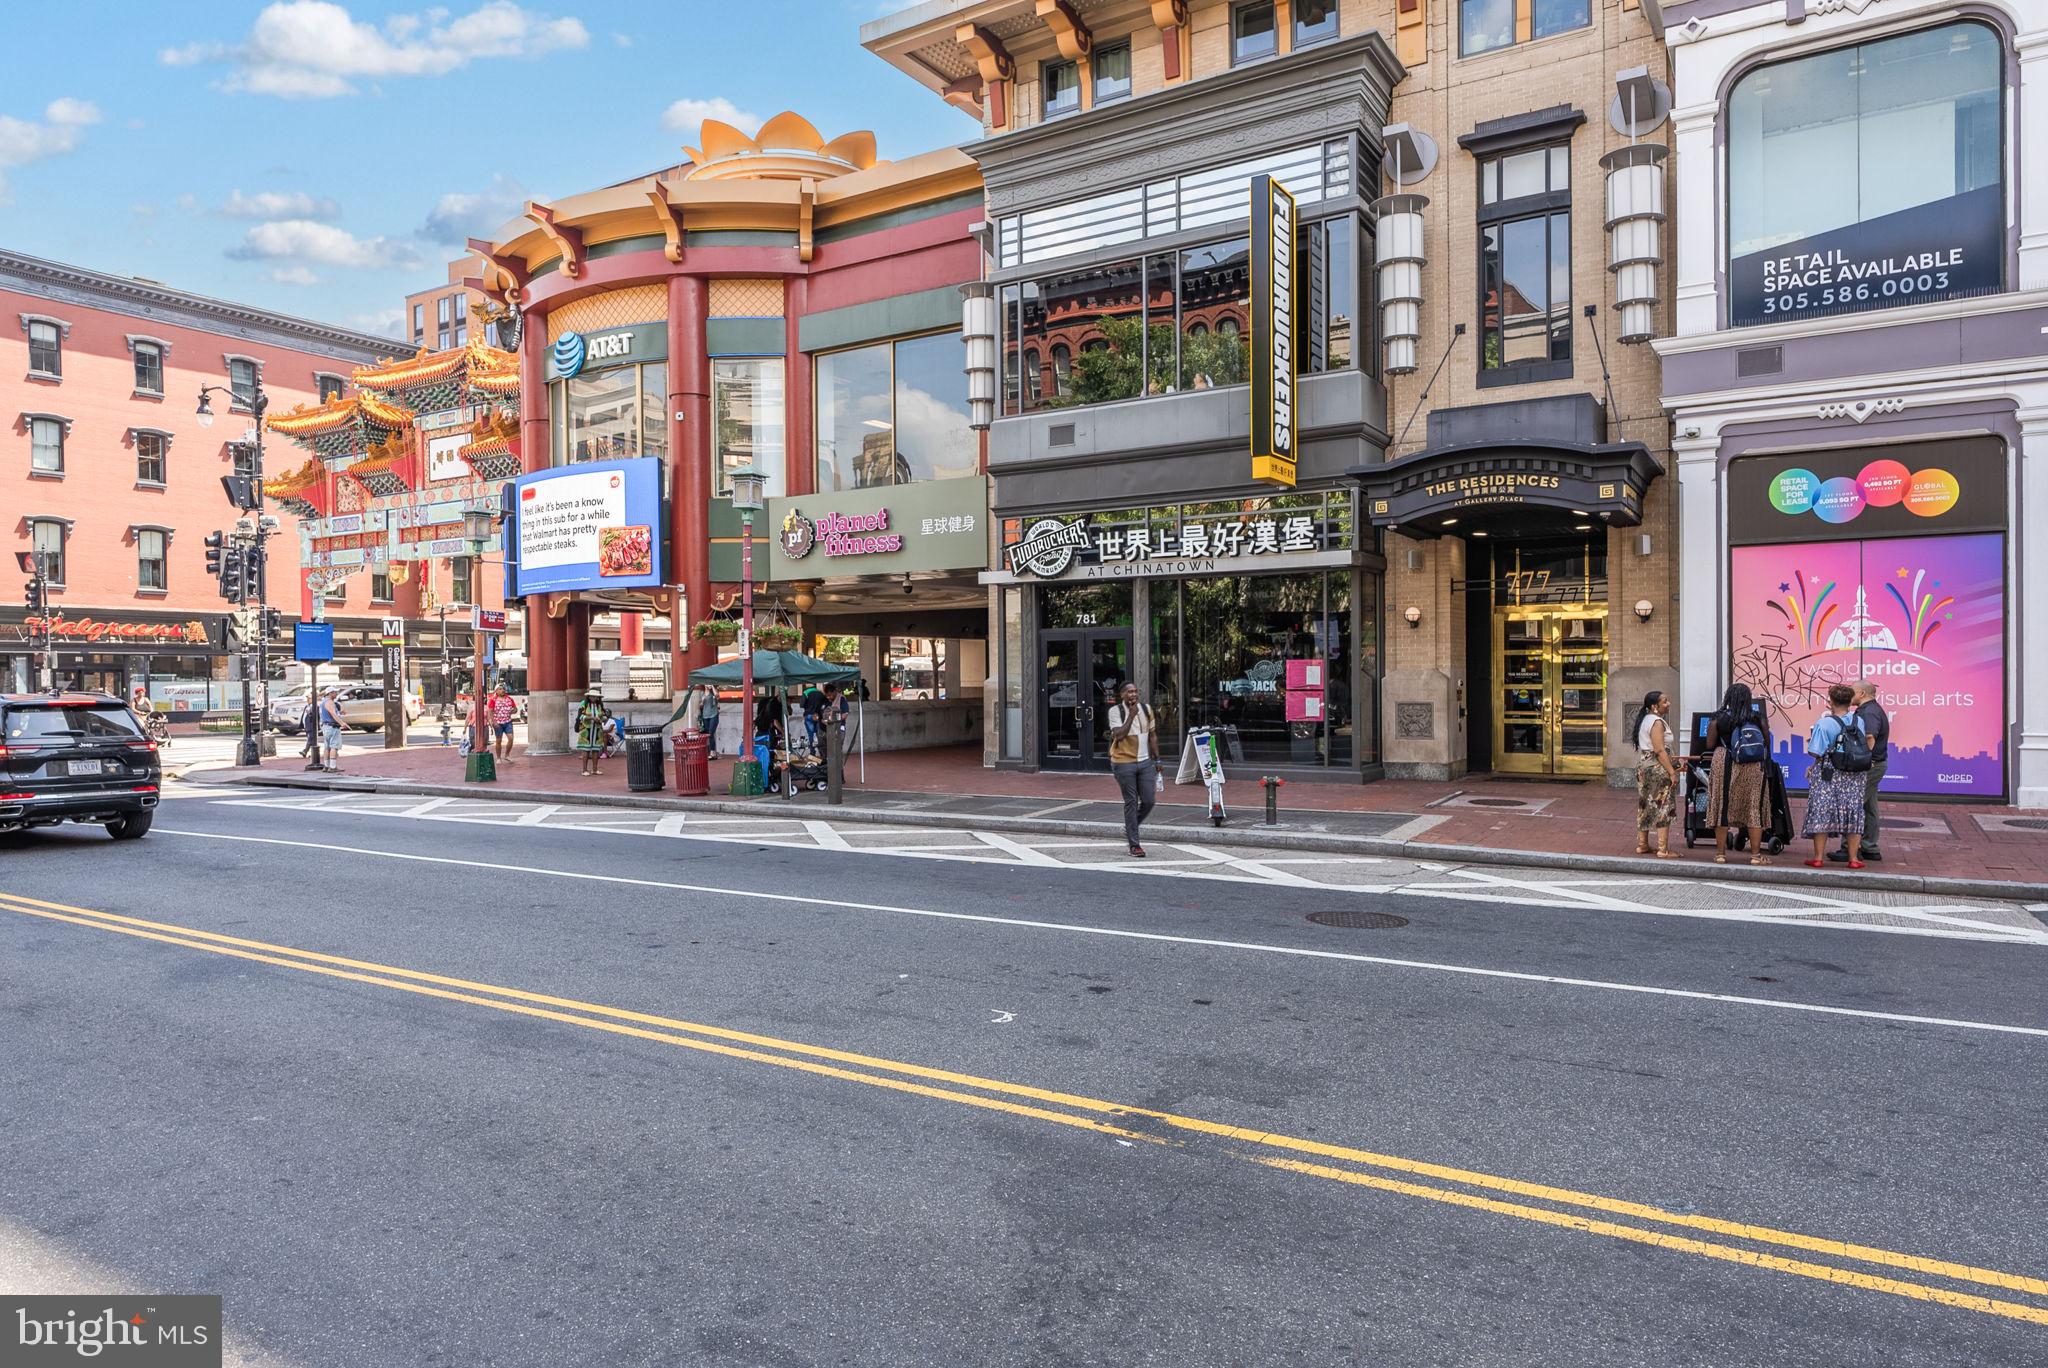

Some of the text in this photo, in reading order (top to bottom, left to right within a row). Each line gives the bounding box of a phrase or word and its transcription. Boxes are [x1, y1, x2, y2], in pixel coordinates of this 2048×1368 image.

[1763, 249, 1850, 276] RETAIL
[1763, 247, 1964, 293] SPACE AVAILABLE
[1763, 271, 1950, 314] 305.586.0003
[1273, 191, 1290, 451] FUDDRUCKERS
[587, 332, 634, 360] AT&T
[1425, 474, 1560, 497] THE RESIDENCES
[1779, 477, 1809, 486] RETAIL
[1780, 484, 1809, 492] SPACE
[534, 503, 545, 515] like
[545, 501, 555, 513] it's
[555, 500, 573, 511] been
[575, 500, 580, 509] a
[581, 497, 604, 507] know
[1781, 497, 1809, 506] LEASE
[535, 517, 541, 527] in
[542, 514, 553, 526] this
[554, 513, 566, 524] sub
[567, 511, 579, 523] for
[580, 513, 586, 521] a
[587, 509, 610, 520] while
[815, 507, 888, 541] planet
[920, 514, 976, 536] 星球健身
[533, 528, 558, 540] Walmart
[558, 526, 571, 536] has
[572, 525, 598, 537] pretty
[788, 529, 803, 548] pf
[1095, 516, 1316, 563] 世界上最好漢堡
[522, 539, 578, 554] respectable steaks.
[824, 533, 902, 558] fitness
[1006, 517, 1092, 577] FUDDRUCKERS
[1087, 559, 1215, 578] AT CHINATOWN
[1505, 570, 1551, 593] 777
[24, 616, 183, 642] Walgreens
[383, 620, 400, 636] M
[1076, 614, 1097, 625] 781
[1933, 691, 1974, 706] arts
